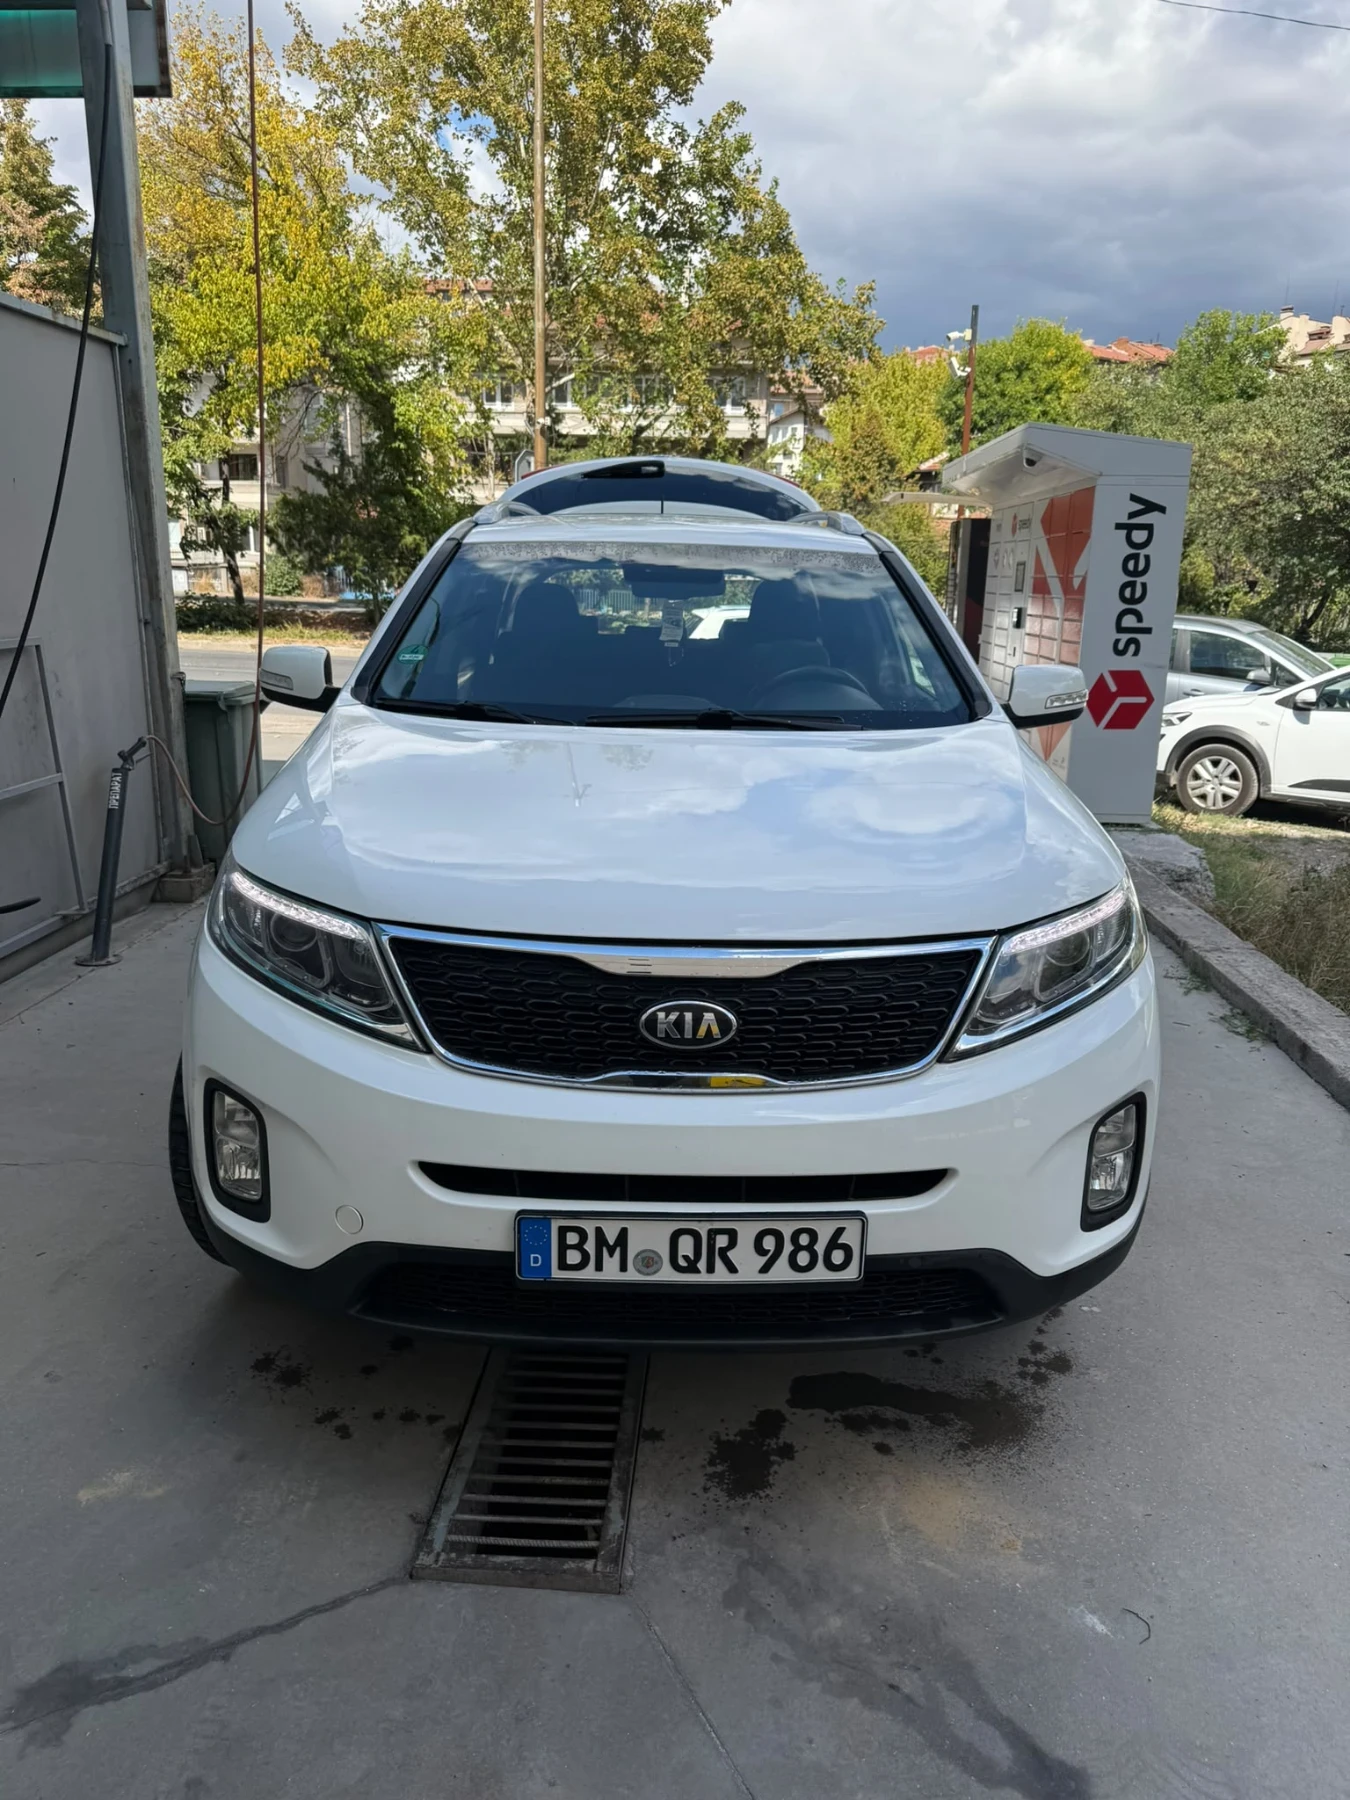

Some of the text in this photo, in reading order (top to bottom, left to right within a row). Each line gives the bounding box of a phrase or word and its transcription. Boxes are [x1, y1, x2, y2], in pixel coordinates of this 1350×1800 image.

[1112, 493, 1167, 657] speedy
[108, 772, 122, 809] ПРЕПАРАТ
[656, 1011, 721, 1038] KIA
[529, 1254, 542, 1267] D
[557, 1225, 628, 1273] BM
[669, 1227, 739, 1274] QR
[753, 1226, 854, 1274] 986
